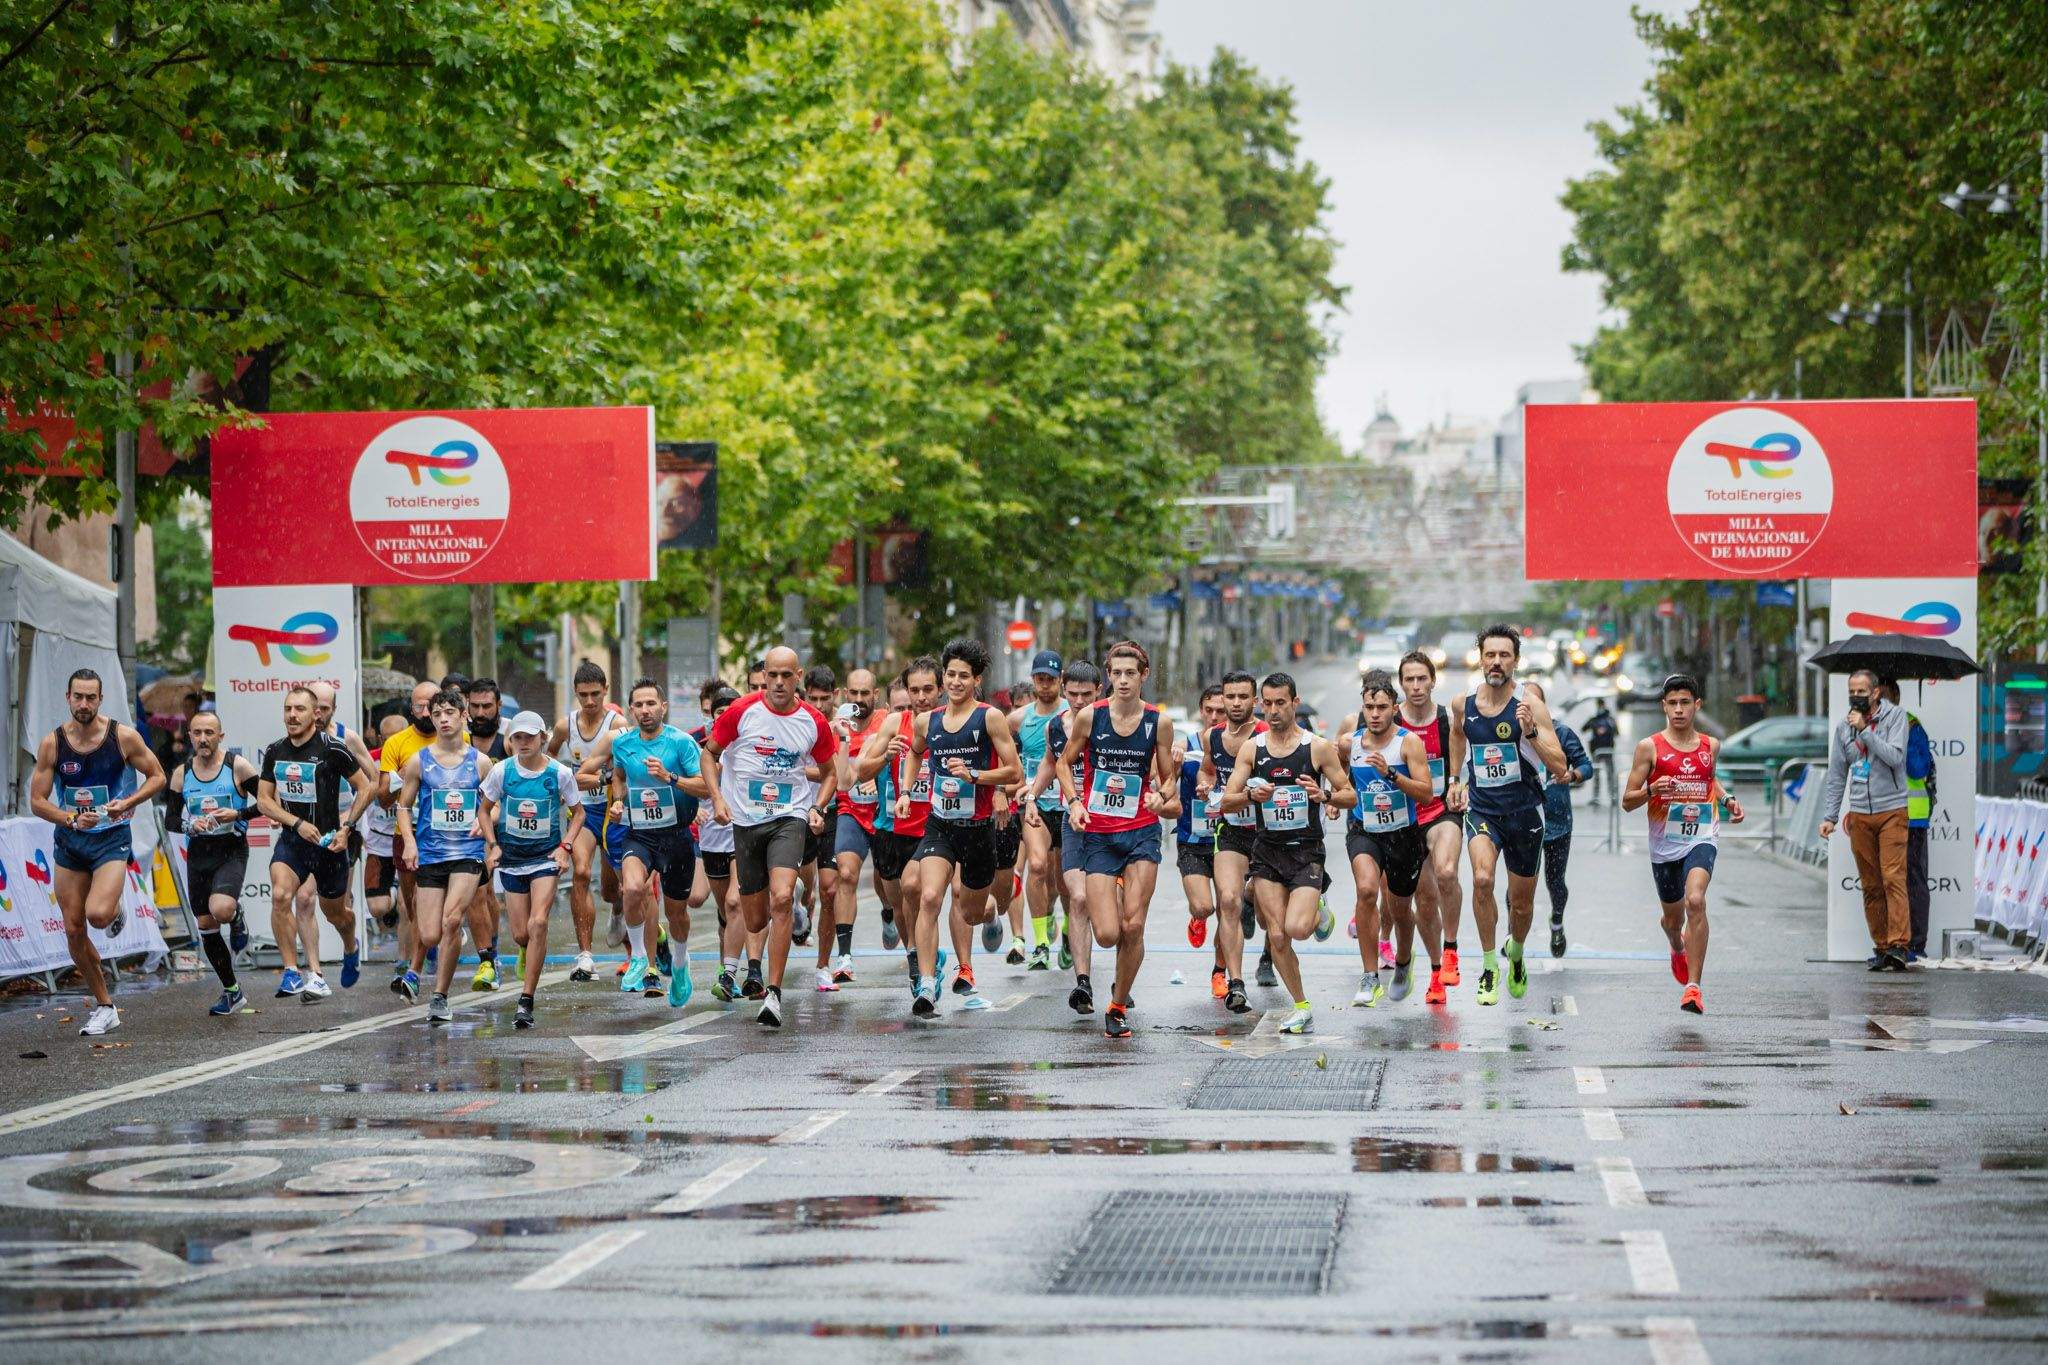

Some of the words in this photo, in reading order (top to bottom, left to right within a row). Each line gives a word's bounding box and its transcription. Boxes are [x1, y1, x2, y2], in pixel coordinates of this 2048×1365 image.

[43, 407, 76, 418] VILL
[1704, 488, 1802, 504] TotalEnergies
[385, 495, 480, 511] TotalEnergies
[1728, 517, 1774, 530] MILLA
[409, 524, 454, 537] MILLA
[392, 553, 413, 565] DE
[415, 552, 471, 565] MADRID
[1711, 546, 1732, 559] DE
[1734, 546, 1792, 559] MADRID
[1485, 764, 1507, 778] 136
[285, 782, 304, 794] 153
[912, 780, 928, 794] 25
[940, 798, 961, 811] 104
[1103, 794, 1126, 808] 103
[444, 810, 465, 823] 138
[643, 807, 663, 820] 148
[1273, 808, 1295, 821] 145
[1375, 810, 1395, 824] 151
[516, 819, 538, 832] 143
[1680, 822, 1700, 836] 137
